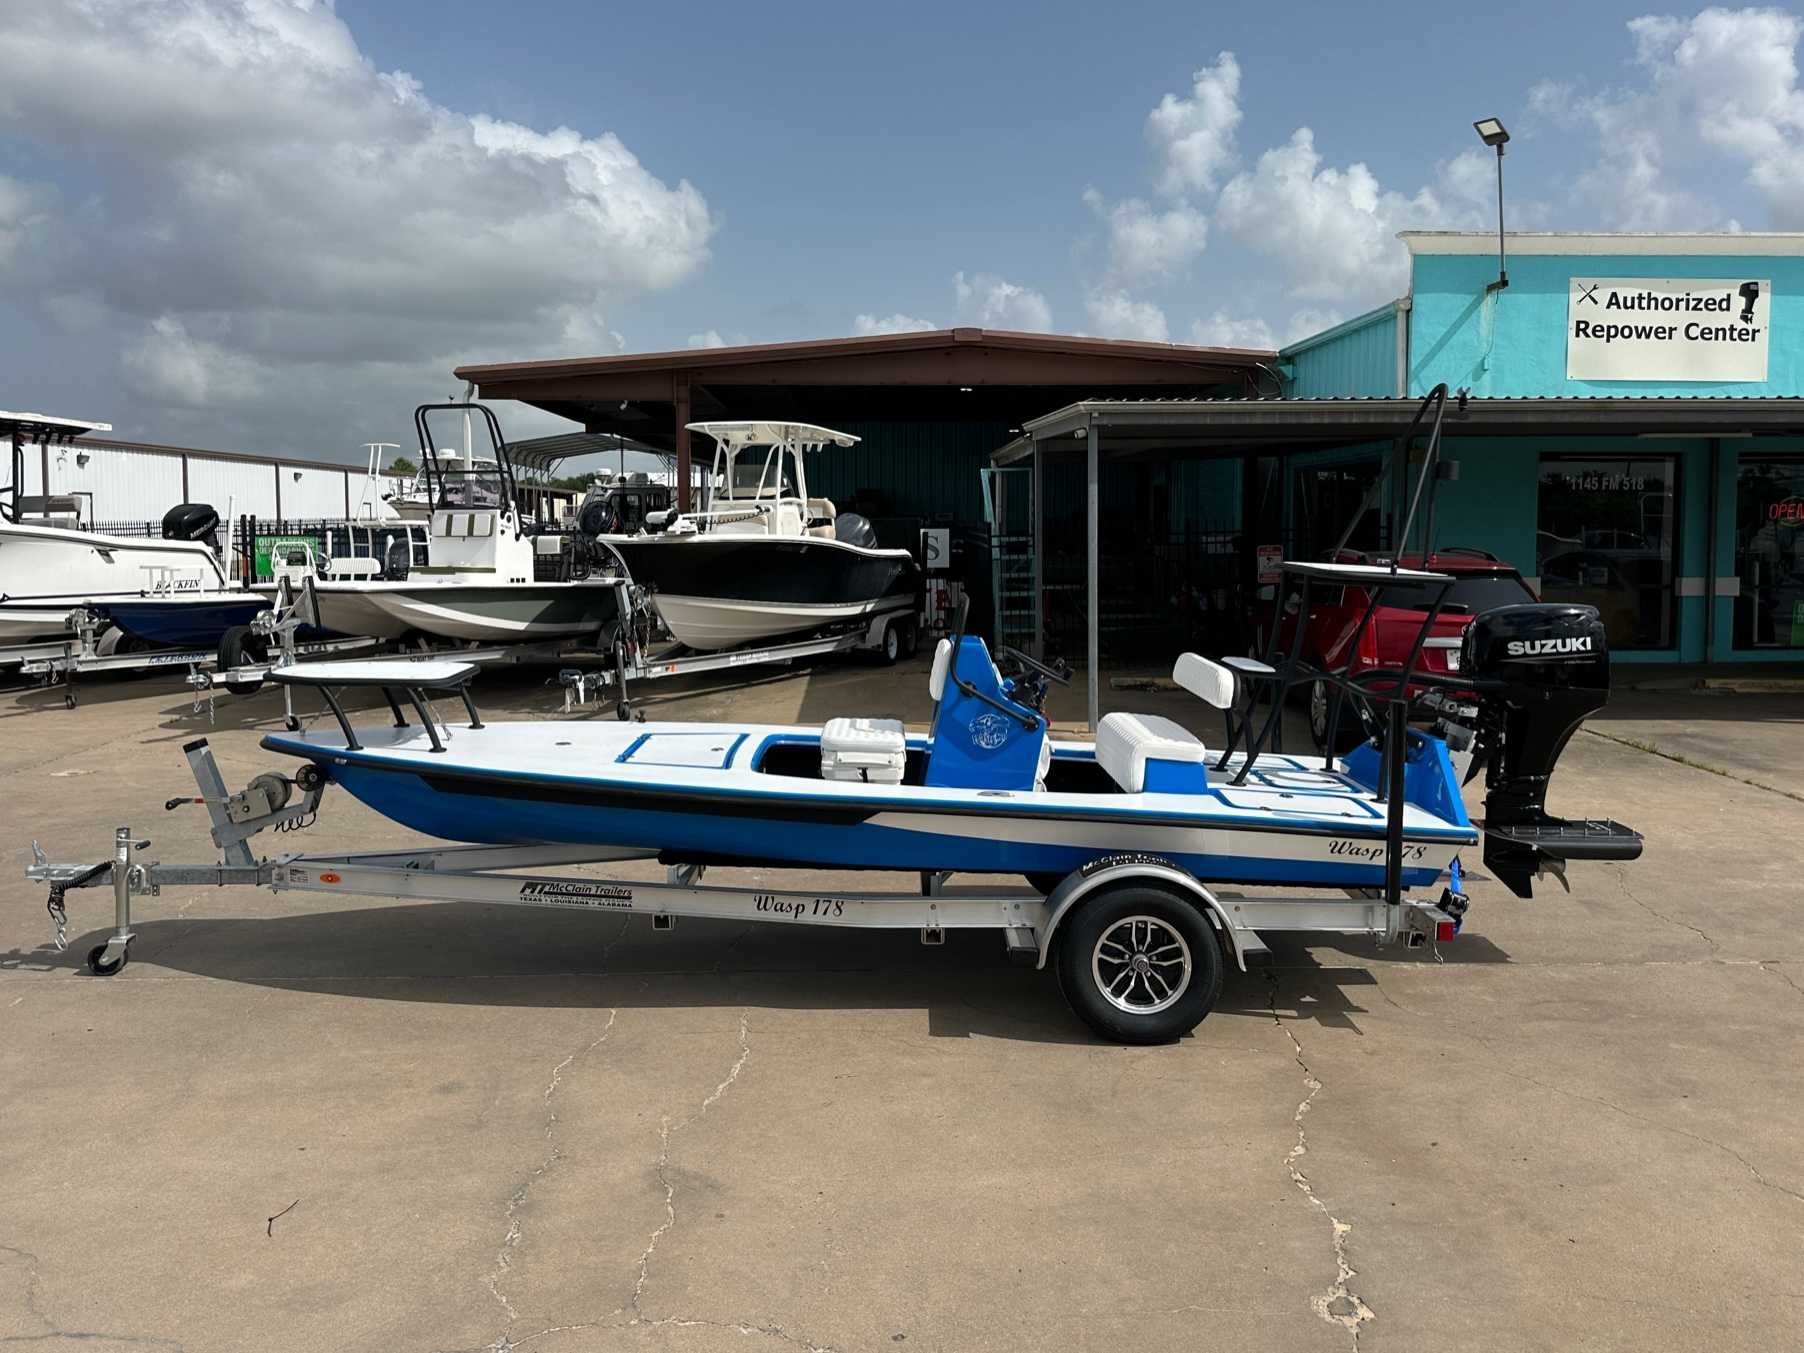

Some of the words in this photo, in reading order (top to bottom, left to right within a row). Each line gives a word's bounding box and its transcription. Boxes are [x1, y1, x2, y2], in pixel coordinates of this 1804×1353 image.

[1605, 291, 1732, 313] Authorized
[1574, 319, 1678, 343] Repower
[1683, 322, 1761, 342] Center
[1570, 476, 1599, 491] 1145
[1601, 477, 1620, 491] FM
[1623, 476, 1645, 491] 518
[1507, 636, 1592, 656] SUZUKI
[1329, 839, 1384, 861] Wasp
[1401, 844, 1427, 860] 78
[548, 882, 592, 894] McClain
[594, 885, 632, 897] Trailers
[754, 895, 805, 919] Wasp
[812, 898, 845, 917] 178
